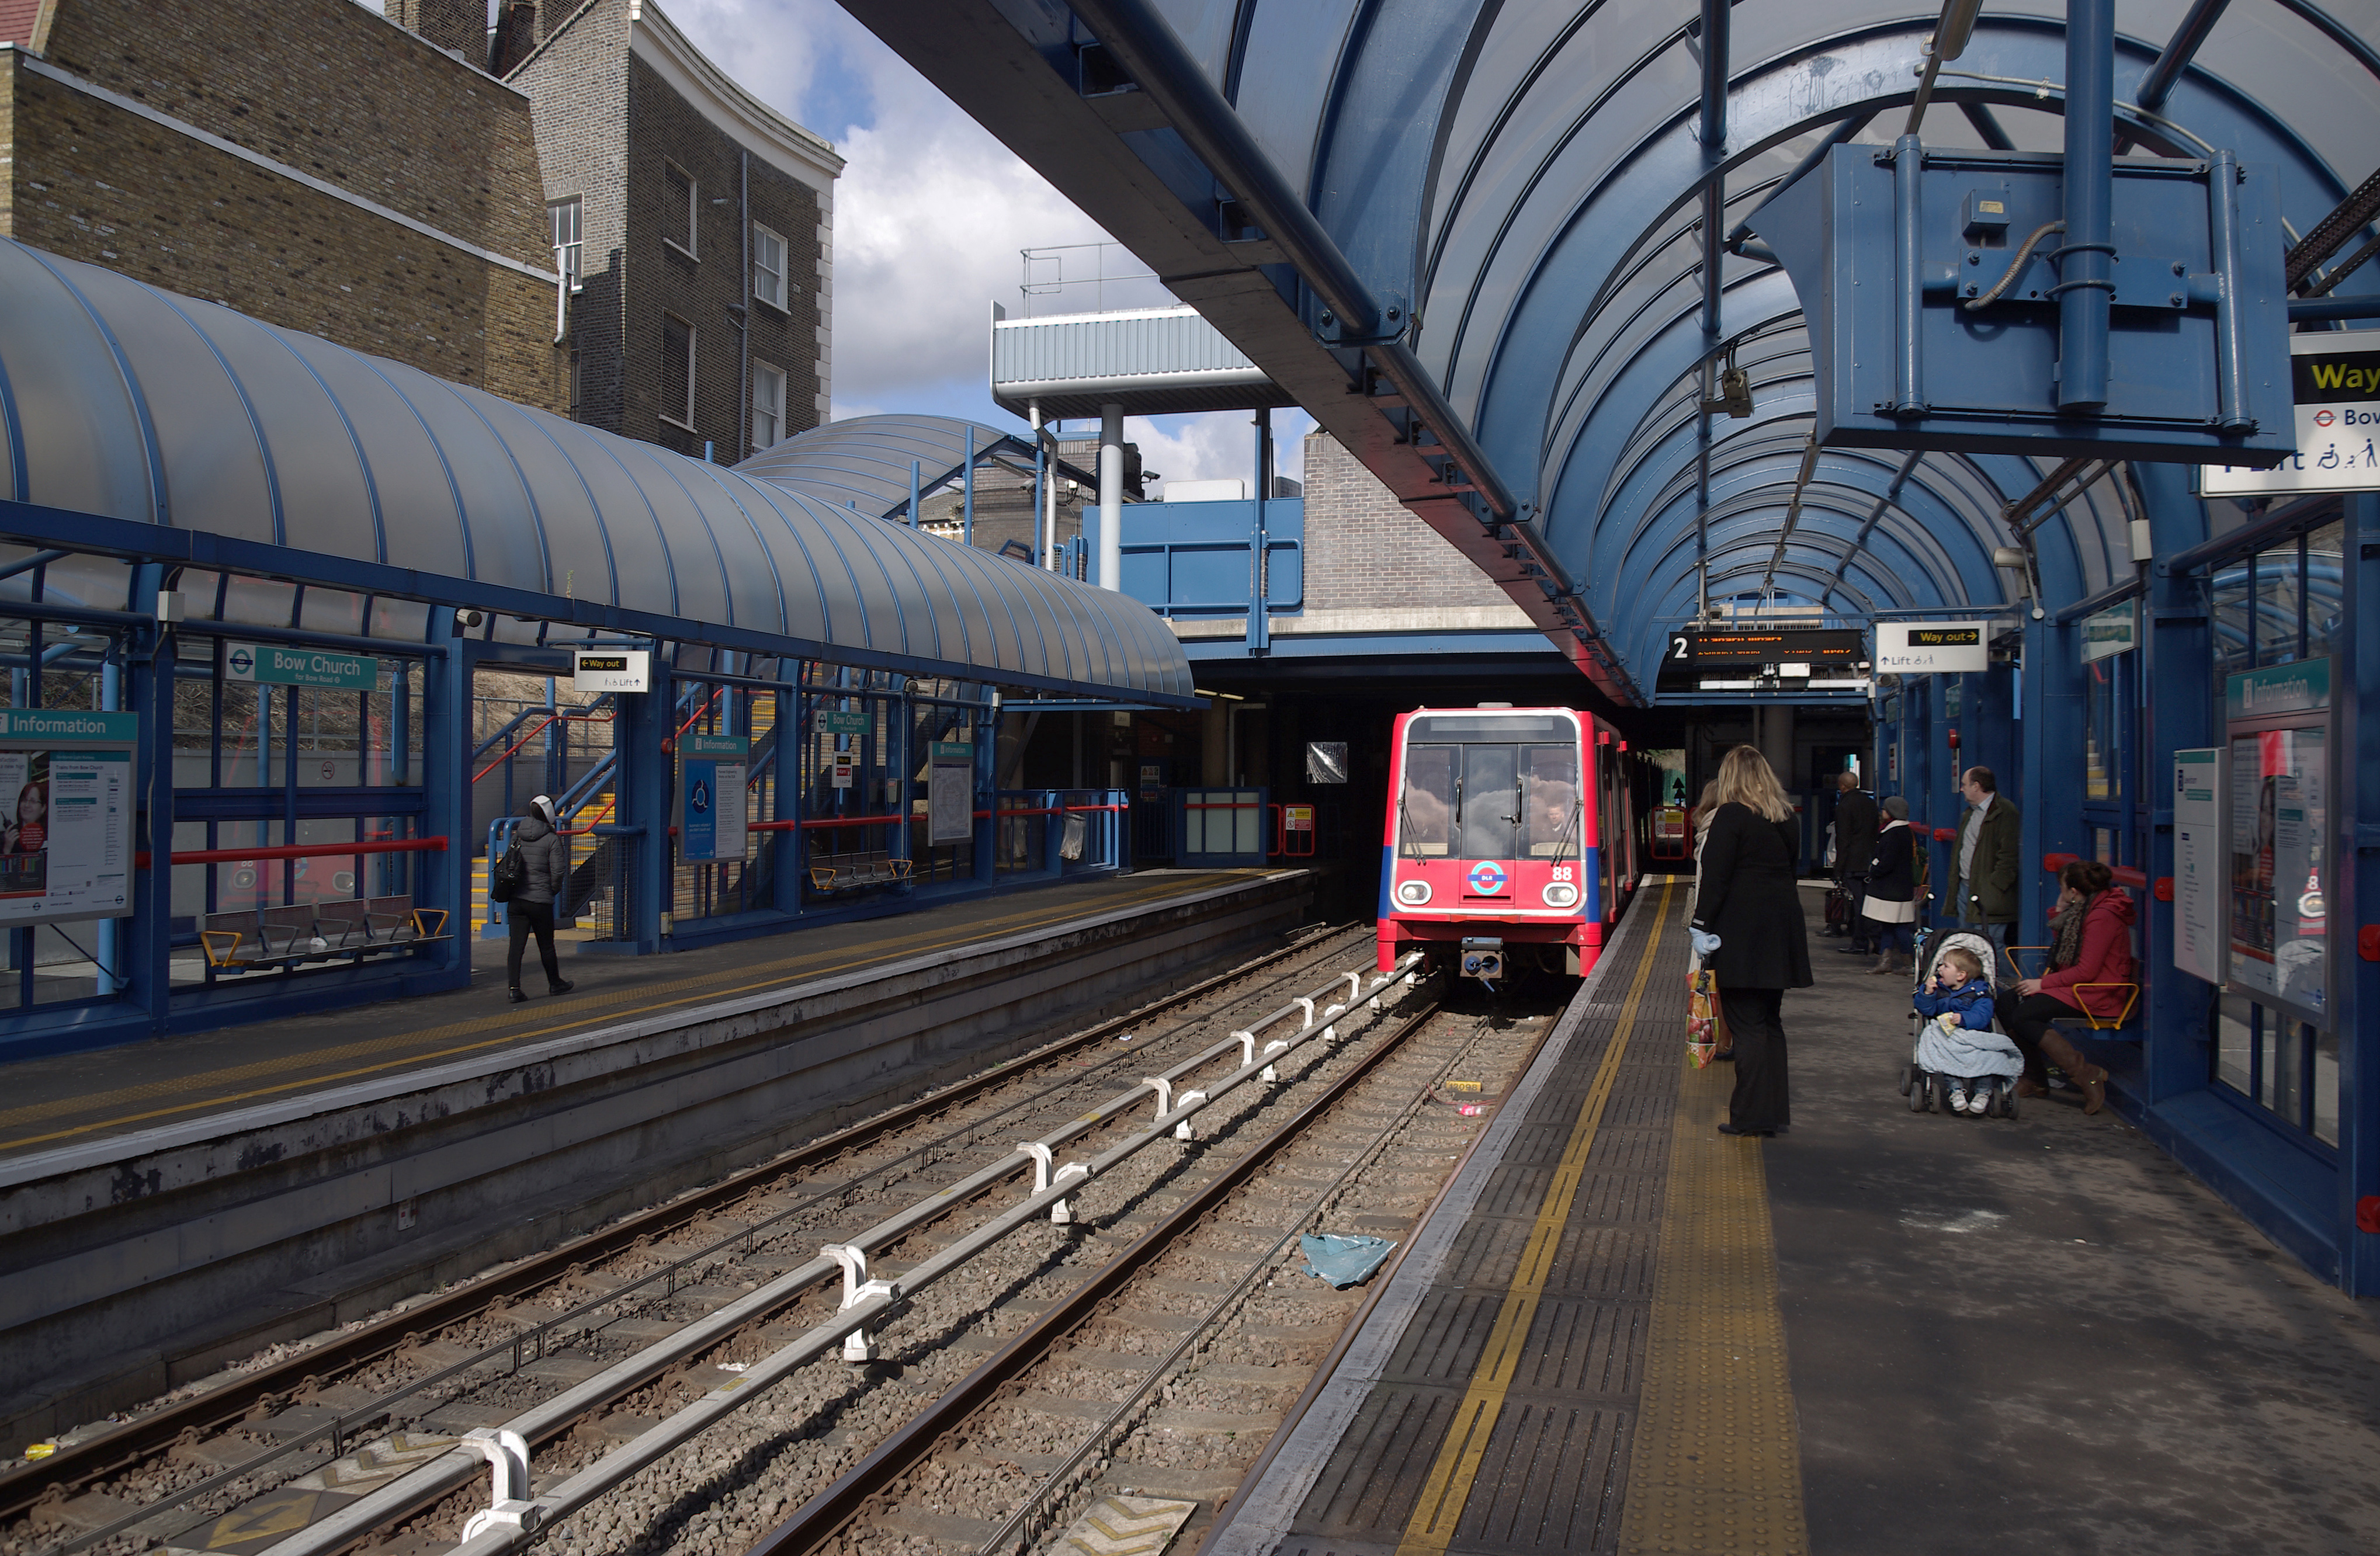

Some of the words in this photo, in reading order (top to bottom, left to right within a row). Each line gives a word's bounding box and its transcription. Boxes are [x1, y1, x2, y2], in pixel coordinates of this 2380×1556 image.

[2311, 363, 2380, 393] Way
[1920, 632, 1943, 643] Way
[1947, 633, 1966, 641] out
[1674, 637, 1688, 658] 2
[274, 652, 306, 671] Bow
[311, 655, 360, 675] Church
[589, 659, 604, 669] Way
[1892, 657, 1911, 665] Lift
[2254, 675, 2308, 703] Information
[14, 716, 106, 734] Information
[833, 714, 845, 724] Bow
[846, 714, 865, 725] Church
[703, 739, 737, 750] Information
[945, 745, 966, 753] Information
[1552, 867, 1572, 881] 88
